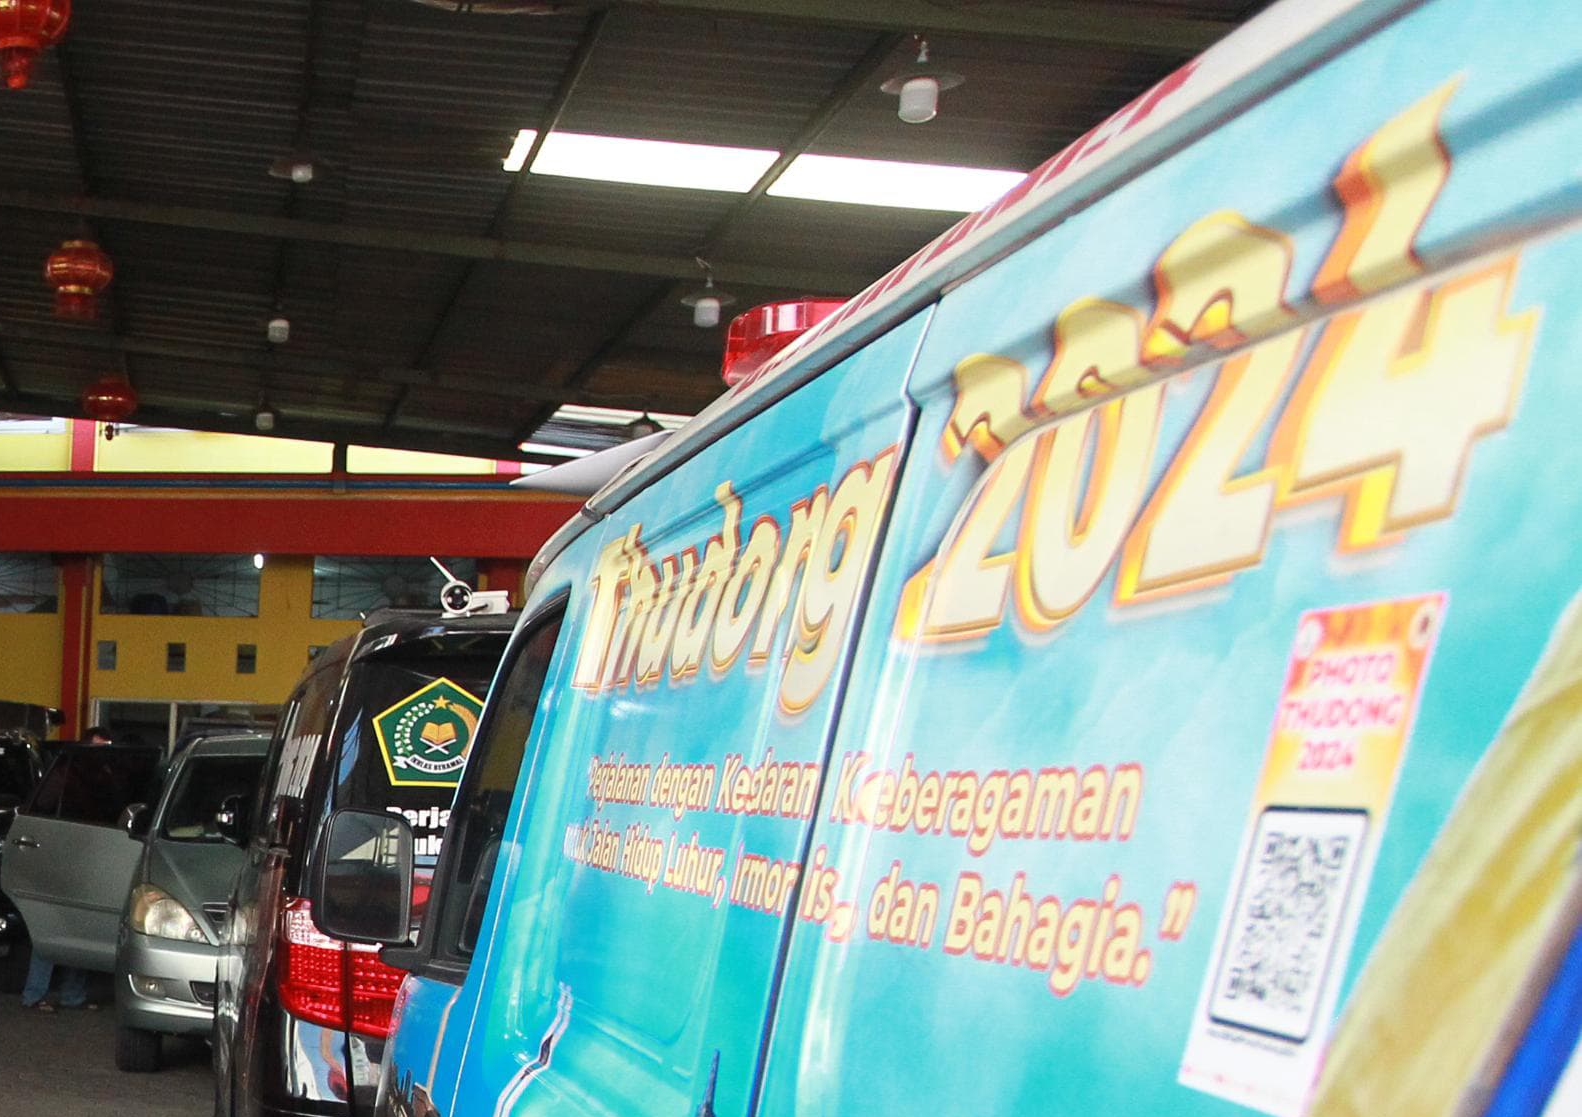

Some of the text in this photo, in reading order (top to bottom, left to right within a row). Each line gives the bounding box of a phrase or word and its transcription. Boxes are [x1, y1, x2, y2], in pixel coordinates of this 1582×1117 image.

[571, 70, 1539, 717] Thudong 2024
[1309, 652, 1396, 685] PHOTO
[1280, 694, 1402, 727] THUDONG
[1298, 740, 1355, 771] 2024
[650, 751, 716, 821] dengan
[829, 752, 1143, 857] Keberagaman
[586, 819, 621, 873] Jalan
[621, 821, 664, 895] Hidup
[662, 831, 727, 909] Luhur,
[867, 859, 940, 948] dan
